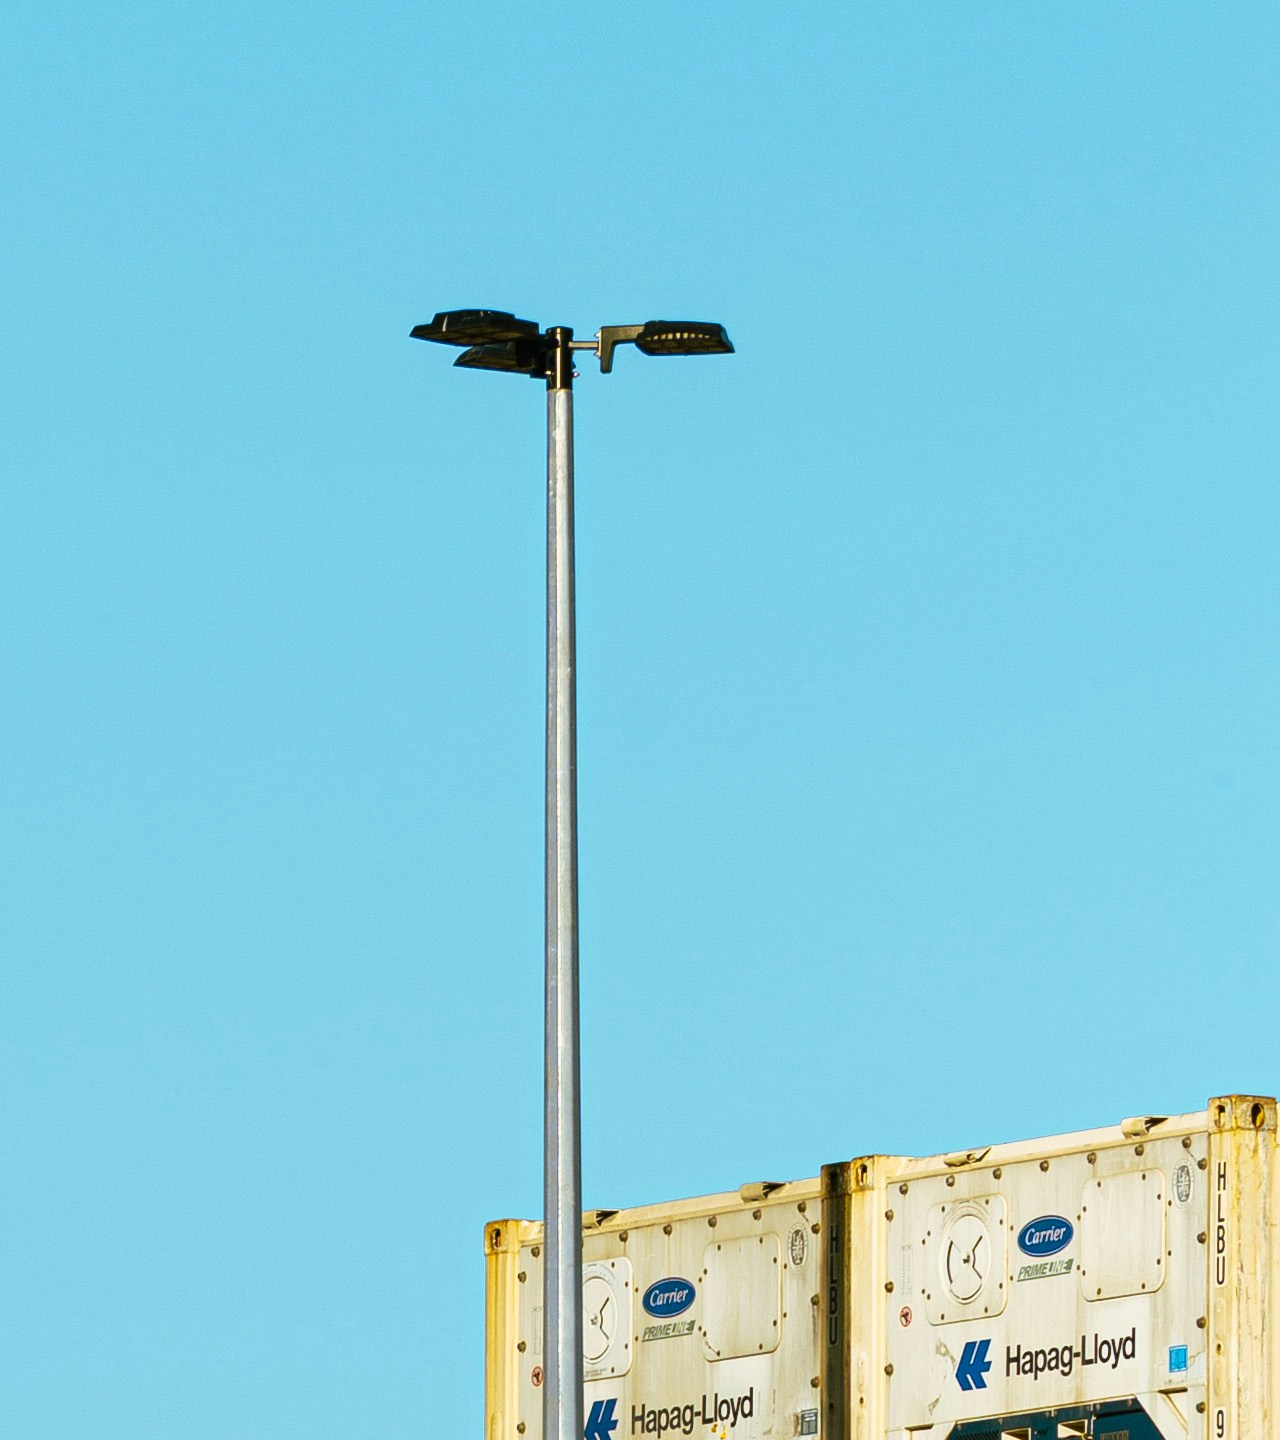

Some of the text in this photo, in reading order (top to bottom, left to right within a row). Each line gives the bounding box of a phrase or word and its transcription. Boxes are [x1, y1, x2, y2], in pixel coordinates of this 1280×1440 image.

[1024, 1223, 1067, 1248] Carrier
[1216, 1161, 1227, 1286] HLBU
[649, 1284, 691, 1308] Carrier
[1005, 1327, 1137, 1380] Hapag-Lloyd
[630, 1387, 755, 1439] Hapag-Lloyd
